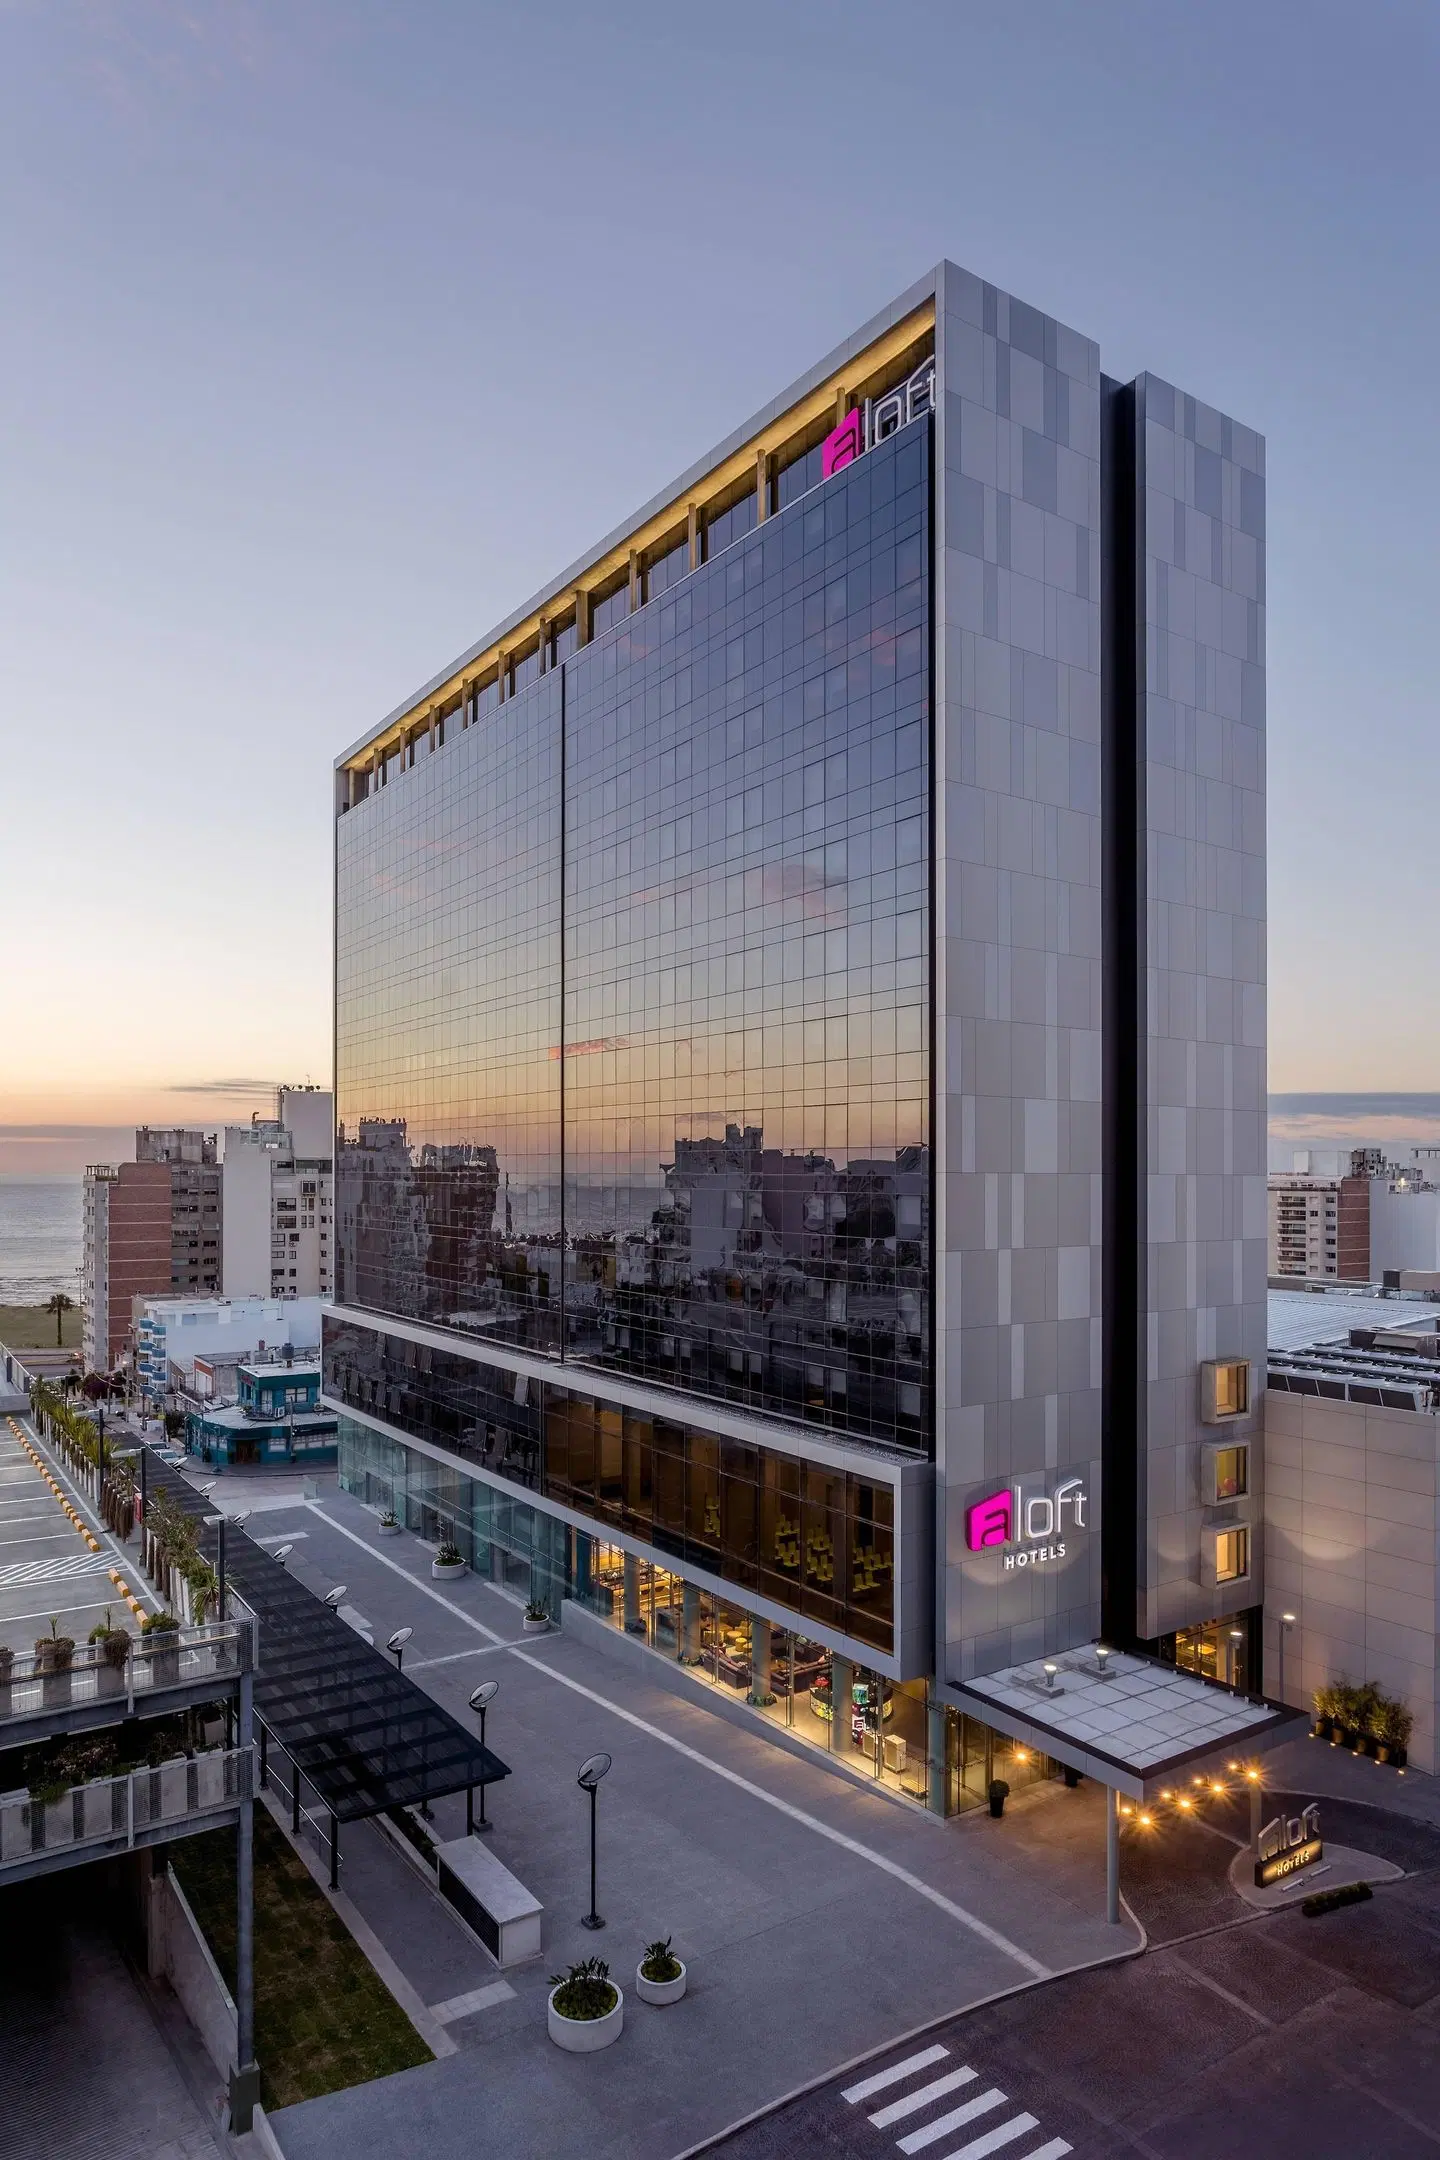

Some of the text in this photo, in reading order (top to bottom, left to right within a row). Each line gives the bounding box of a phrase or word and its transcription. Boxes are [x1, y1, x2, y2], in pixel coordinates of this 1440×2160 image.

[965, 1478, 1087, 1551] aloft
[1004, 1543, 1066, 1570] HOTELS
[1276, 1850, 1310, 1876] HOTELS
